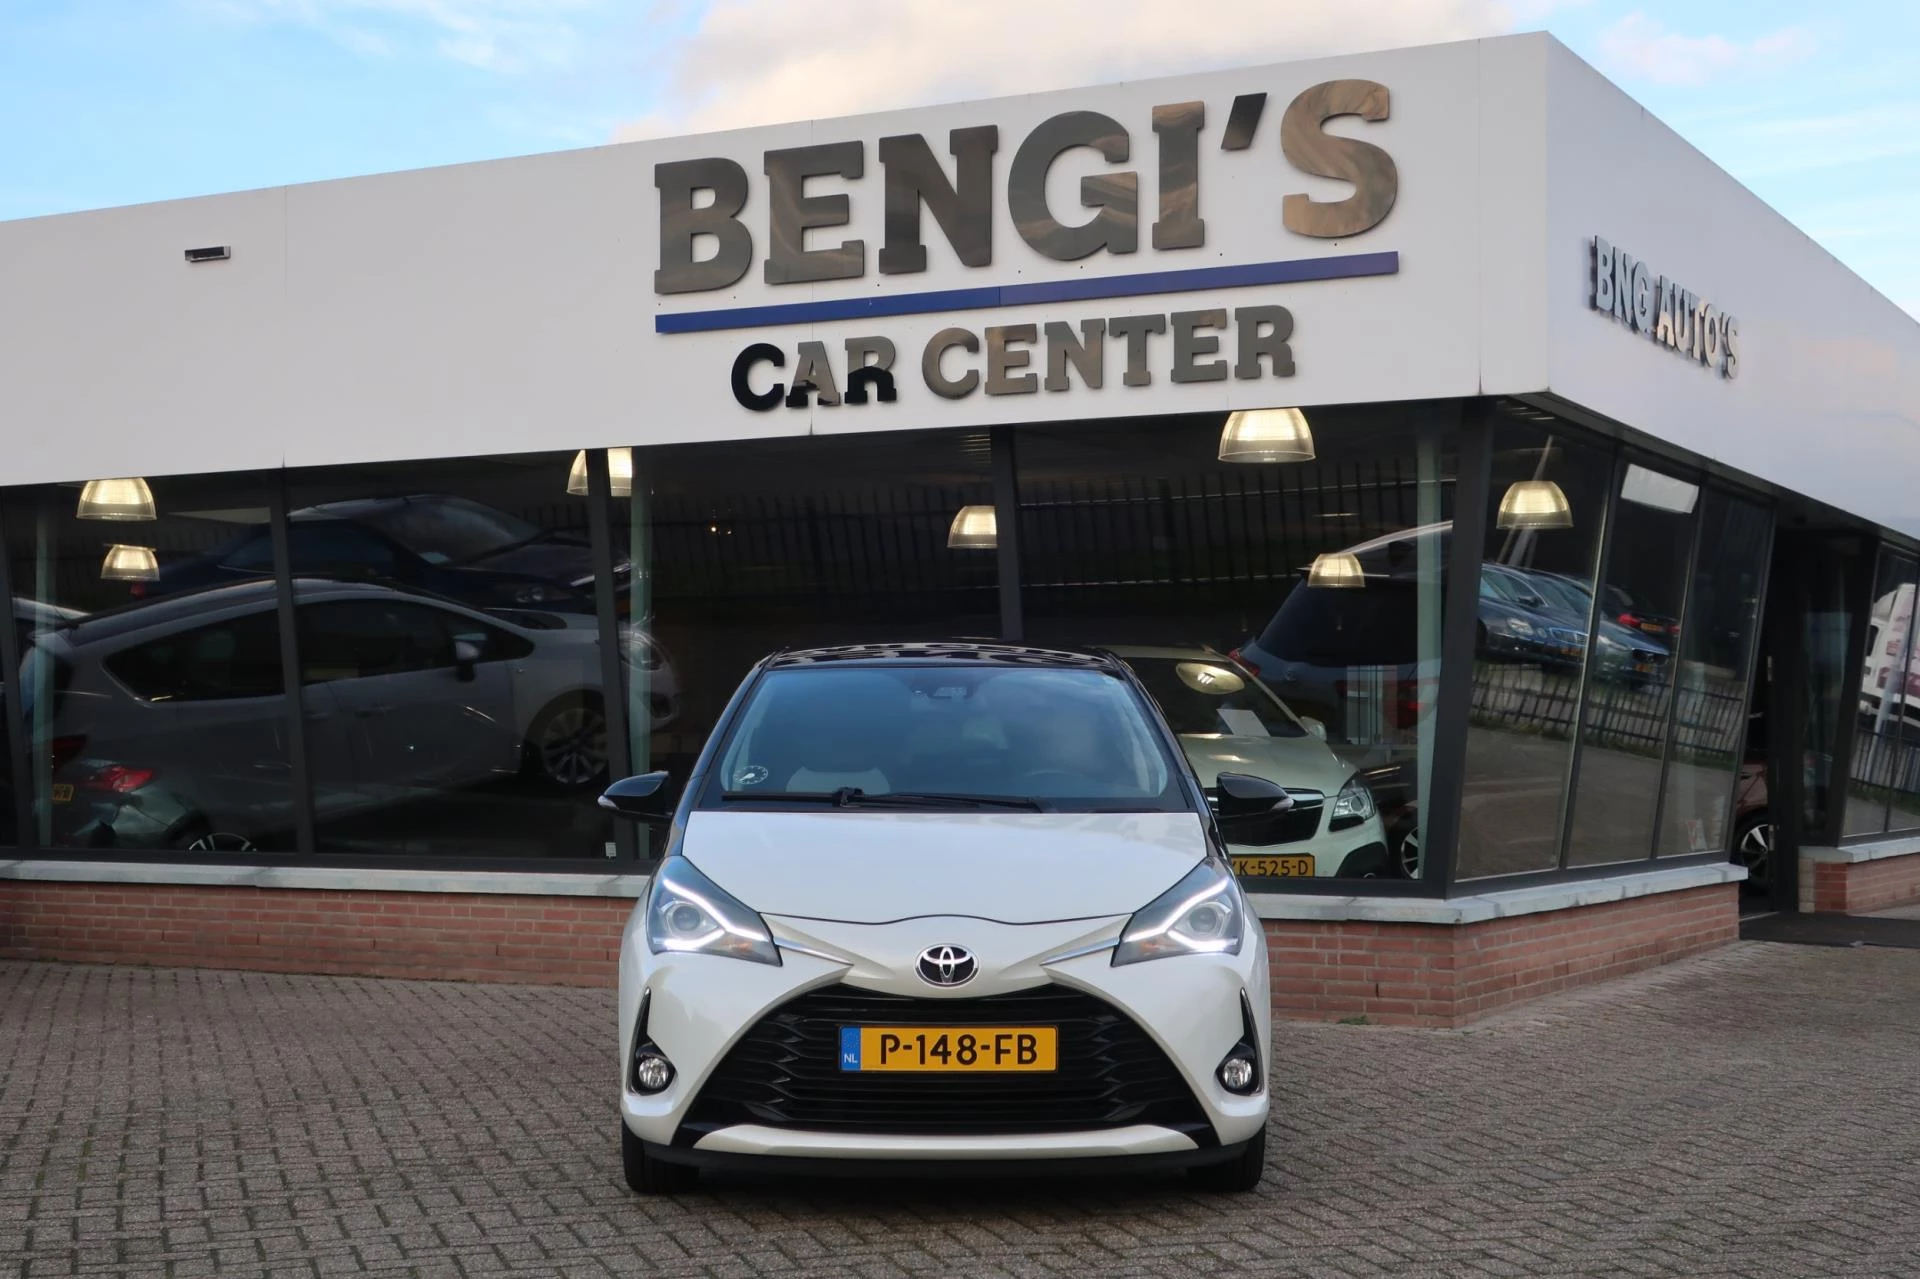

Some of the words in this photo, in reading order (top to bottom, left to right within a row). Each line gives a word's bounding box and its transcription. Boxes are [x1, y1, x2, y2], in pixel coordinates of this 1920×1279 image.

[654, 78, 1399, 294] BENGI'S
[731, 335, 897, 411] CAR
[921, 305, 1296, 400] CENTER
[1592, 235, 1652, 334] BNG
[1656, 275, 1739, 379] AUTO'S
[844, 1053, 858, 1063] NL
[880, 1034, 1037, 1065] P-148-FB
